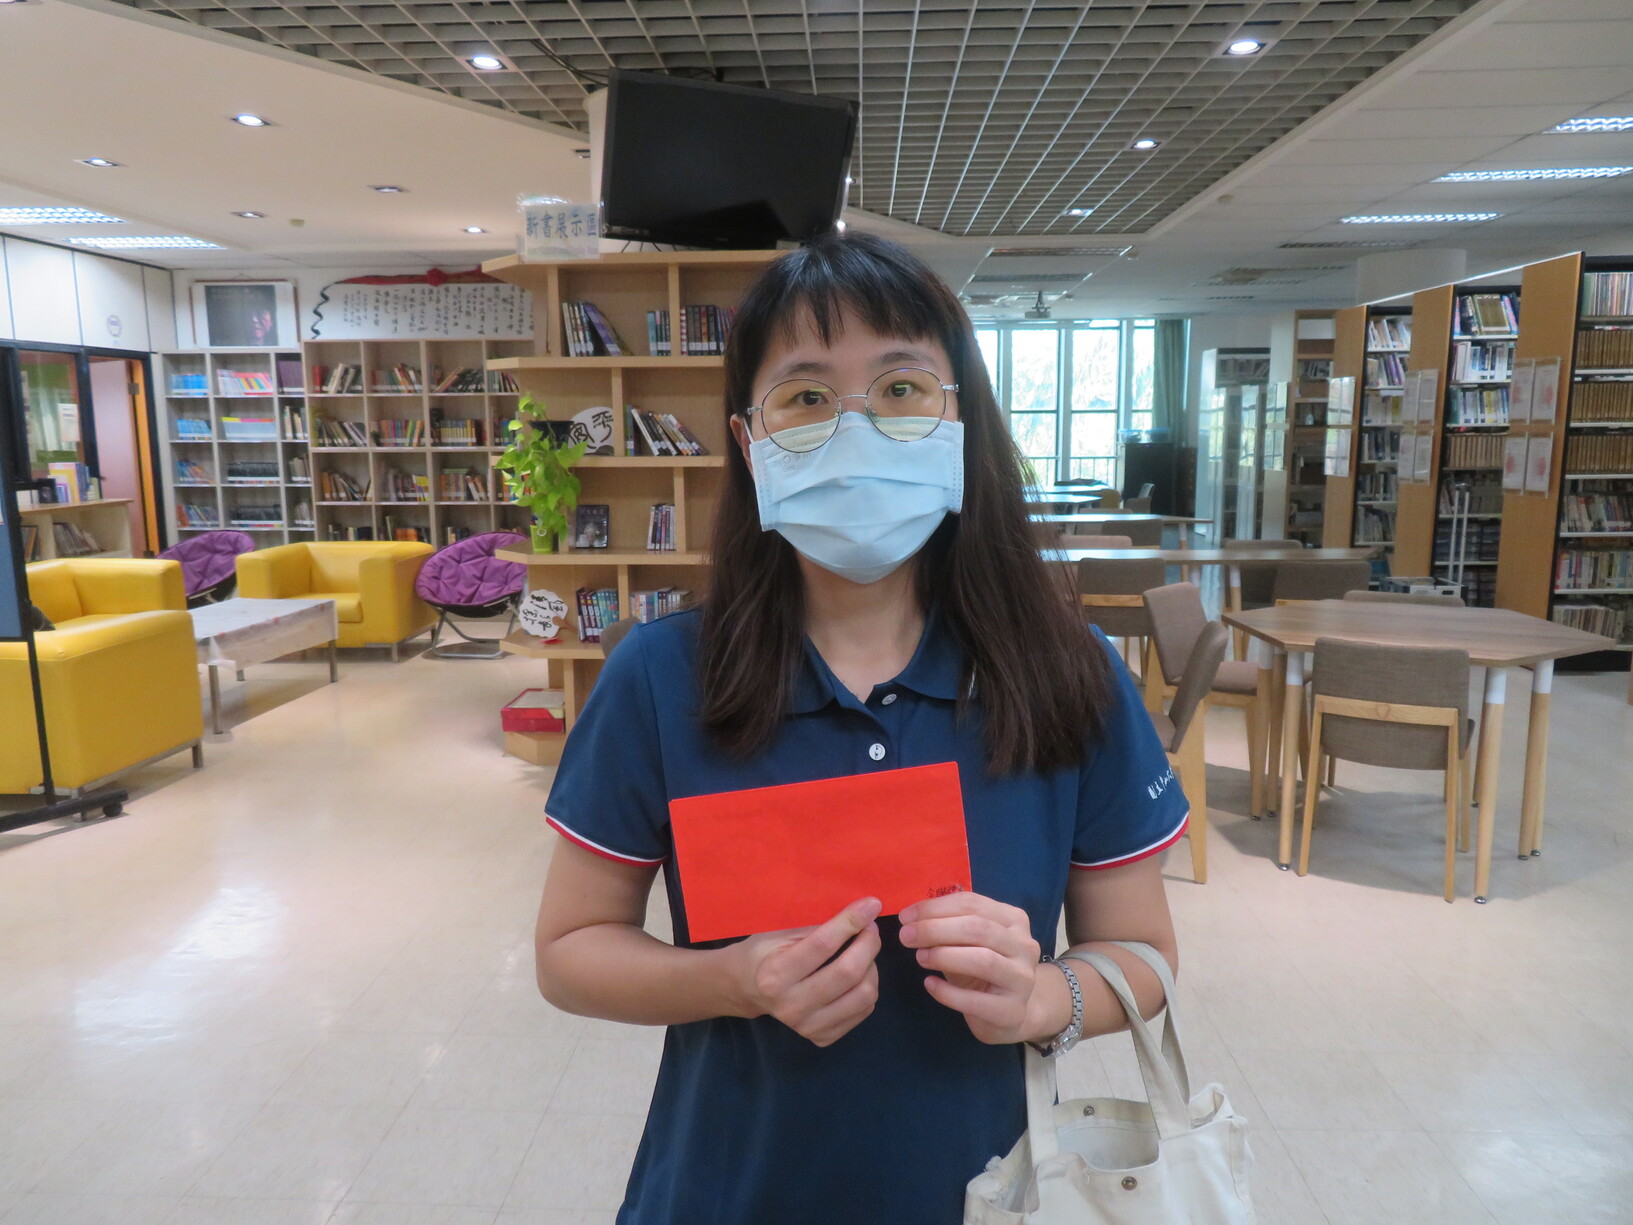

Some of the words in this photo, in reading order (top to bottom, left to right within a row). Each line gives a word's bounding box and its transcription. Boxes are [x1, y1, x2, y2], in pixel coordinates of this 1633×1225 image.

[526, 211, 597, 239] 新書展示區
